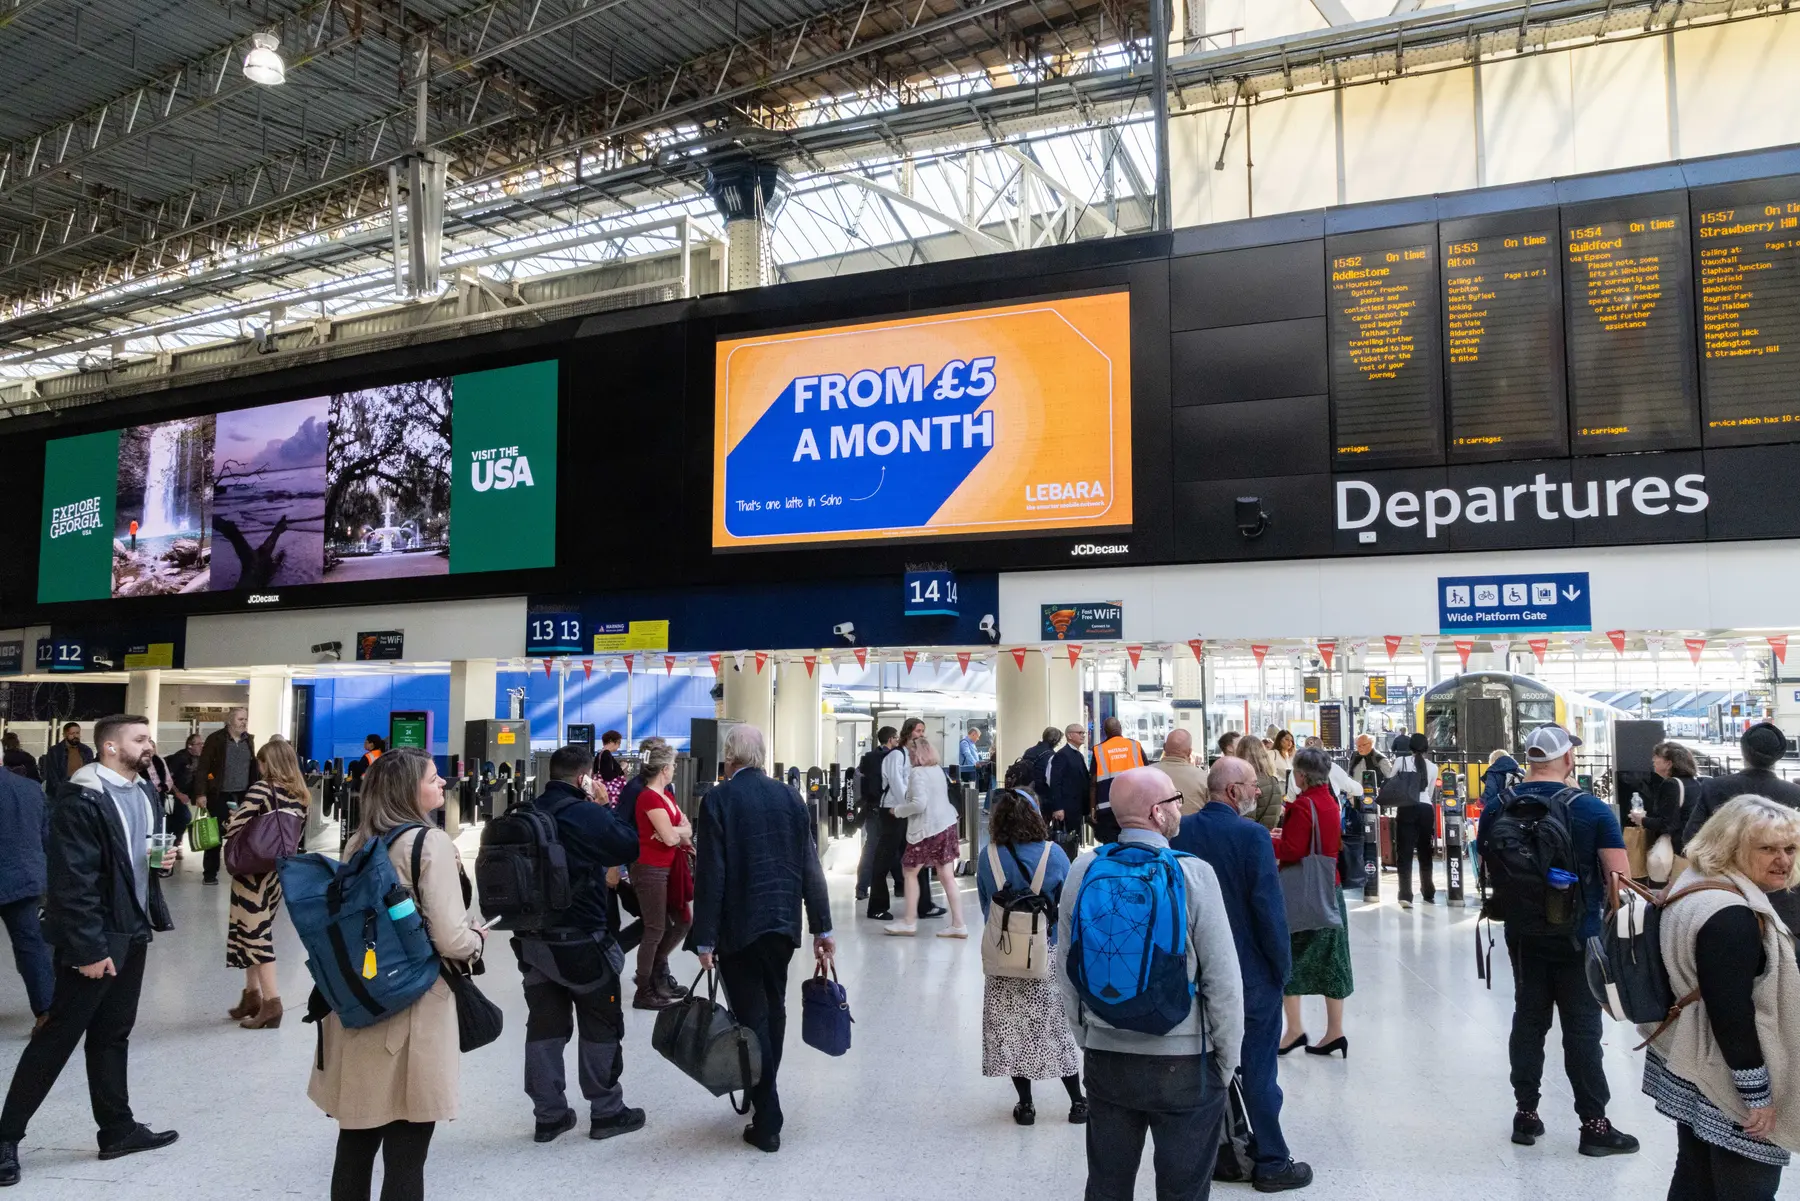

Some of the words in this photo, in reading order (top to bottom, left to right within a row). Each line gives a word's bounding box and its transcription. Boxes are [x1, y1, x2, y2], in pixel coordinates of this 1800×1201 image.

[1701, 210, 1734, 224] 15:57
[1764, 205, 1781, 217] On
[1570, 226, 1603, 240] 15:54
[1629, 222, 1645, 233] On
[1649, 219, 1675, 231] time
[1699, 221, 1775, 238] Strawberry
[1779, 216, 1798, 229] Hill
[1449, 242, 1479, 255] 15:53
[1503, 239, 1519, 248] On
[1523, 236, 1547, 246] time
[1569, 237, 1623, 253] Guildford
[1700, 248, 1729, 257] Calling
[1730, 247, 1743, 255] at:
[1765, 242, 1786, 251] Page
[1333, 256, 1362, 269] 15:52
[1385, 253, 1400, 263] On
[1403, 250, 1425, 261] time
[1447, 257, 1475, 268] Alton
[1587, 261, 1614, 270] Please
[1701, 255, 1738, 267] Vauxhall
[1589, 270, 1607, 279] lifts
[1609, 269, 1619, 277] at
[1621, 265, 1659, 275] Wimbledon
[1737, 263, 1773, 272] Junction
[1447, 278, 1472, 286] Calling
[1603, 275, 1643, 286] currently
[1645, 273, 1659, 281] out
[1702, 273, 1743, 285] Earlsfield
[1351, 289, 1376, 297] Oyster,
[1448, 285, 1479, 295] Surbiton
[1633, 283, 1660, 291] Please
[1702, 284, 1743, 294] Wimbledon
[1360, 296, 1385, 305] passes
[1448, 295, 1465, 303] West
[1468, 292, 1496, 302] Byfleet
[1588, 297, 1610, 306] speak
[1703, 294, 1732, 304] Raynes
[1732, 291, 1753, 301] Park
[1344, 304, 1386, 314] contactless
[1606, 303, 1629, 313] staff
[1641, 302, 1656, 311] you
[1449, 311, 1487, 321] Brookwood
[1599, 314, 1618, 322] need
[1619, 310, 1651, 320] further
[1377, 319, 1403, 328] beyond
[1449, 321, 1463, 329] Ash
[1605, 321, 1647, 331] assistance
[1703, 321, 1740, 332] Kingston
[1449, 327, 1485, 338] Aldershot
[1349, 338, 1385, 347] travelling
[1385, 335, 1413, 344] further
[1705, 339, 1751, 349] Teddington
[1371, 345, 1390, 354] need
[1400, 343, 1415, 352] buy
[1449, 346, 1479, 355] Bentley
[1714, 347, 1764, 358] Strawberry
[1765, 345, 1780, 353] Hill
[1359, 355, 1381, 363] ticket
[1457, 354, 1479, 362] Alton
[1359, 363, 1375, 371] rest
[1388, 362, 1405, 371] your
[794, 364, 924, 414] FROM
[932, 356, 996, 400] £5
[792, 428, 821, 462] A
[830, 411, 993, 459] MONTH
[471, 448, 497, 461] VISIT
[499, 446, 519, 458] THE
[471, 456, 534, 492] USA
[1026, 480, 1104, 502] LEBARA
[735, 500, 762, 512] That's
[765, 500, 781, 510] one
[786, 496, 804, 508] latte
[808, 496, 816, 507] in
[820, 494, 842, 506] Soho
[1336, 473, 1710, 538] Departures
[52, 496, 101, 524] EXPLORE
[1071, 544, 1129, 556] JCDecaux
[910, 580, 940, 602] 14
[946, 580, 958, 604] 14
[248, 594, 280, 604] JCDecaux
[1094, 608, 1120, 620] WiFi
[1447, 612, 1473, 622] Wide
[1475, 611, 1520, 621] Platform
[1522, 610, 1547, 620] Gate
[532, 620, 554, 640] 13
[561, 620, 580, 640] 13
[38, 645, 52, 661] 12
[59, 645, 81, 661] 12
[1450, 858, 1460, 888] PEPSI
